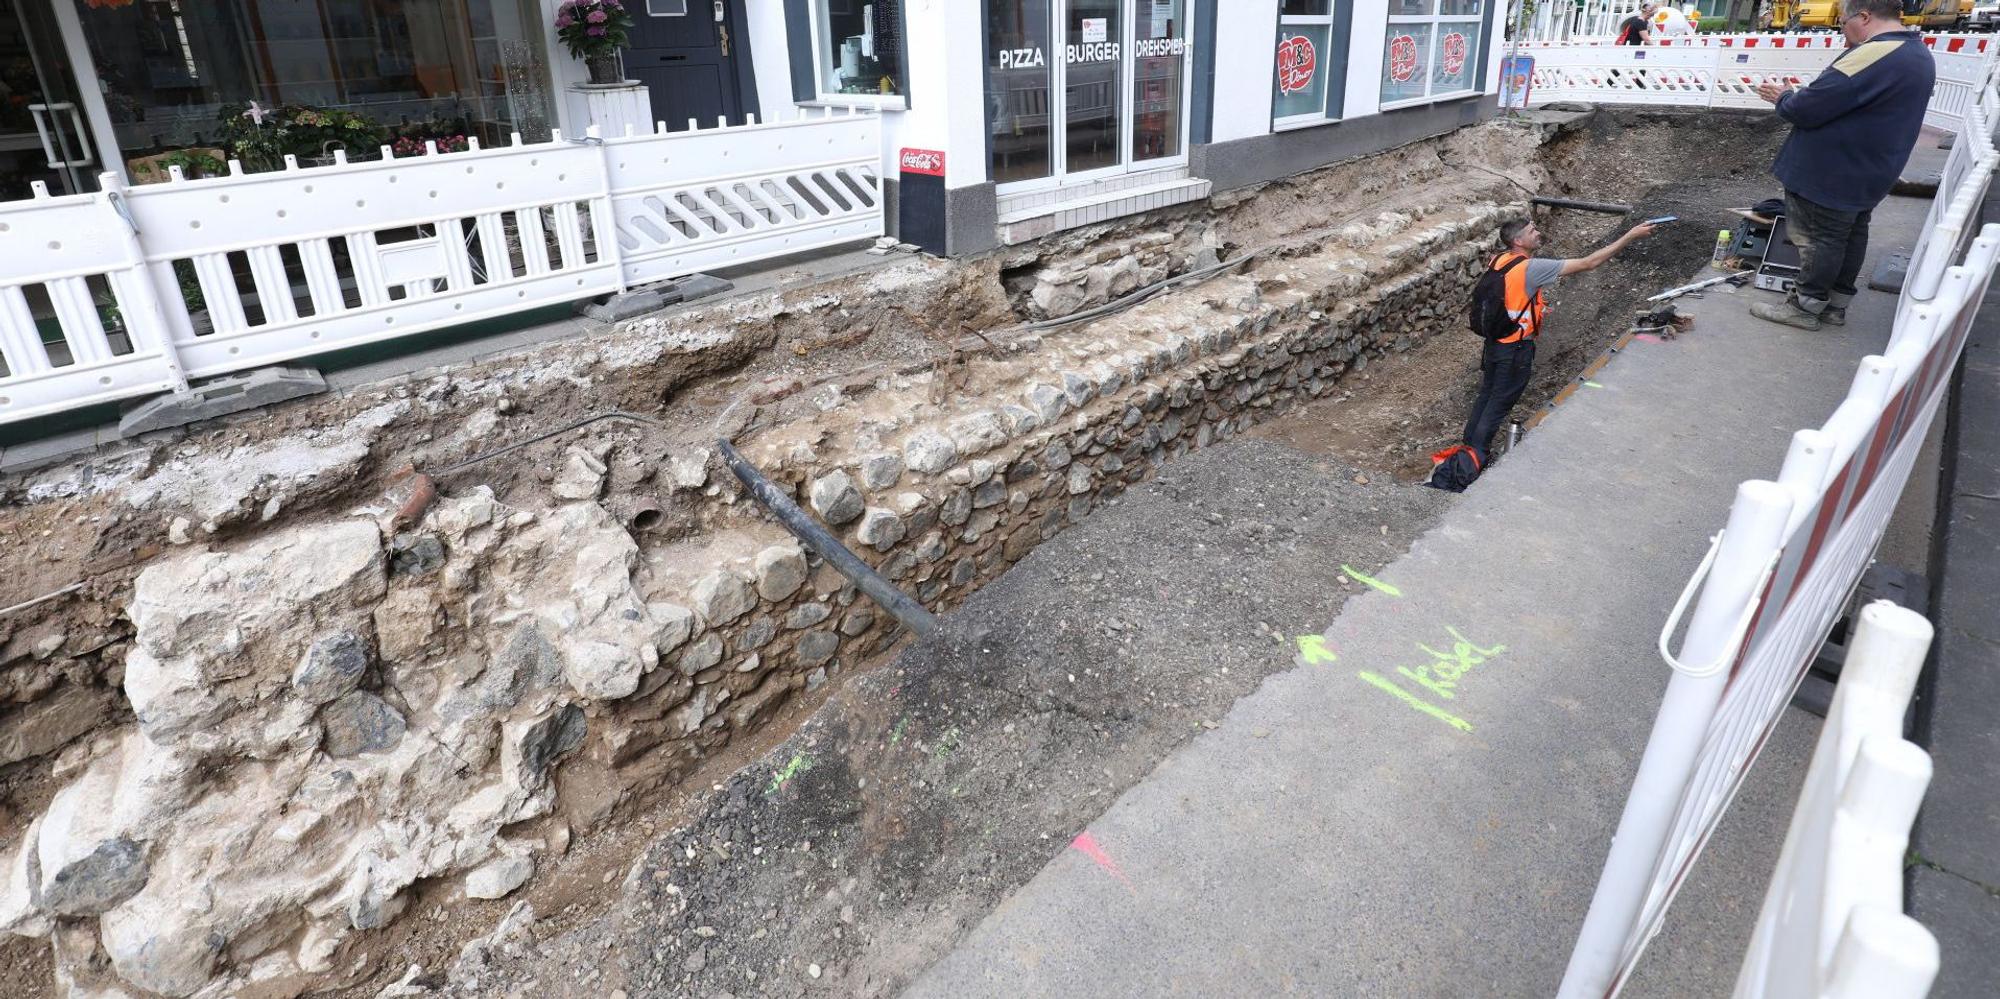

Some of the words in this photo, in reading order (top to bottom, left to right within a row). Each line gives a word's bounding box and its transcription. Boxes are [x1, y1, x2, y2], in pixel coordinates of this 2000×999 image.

[1000, 48, 1044, 69] PIZZA
[1066, 42, 1120, 63] BURGER
[1284, 42, 1312, 68] M&C
